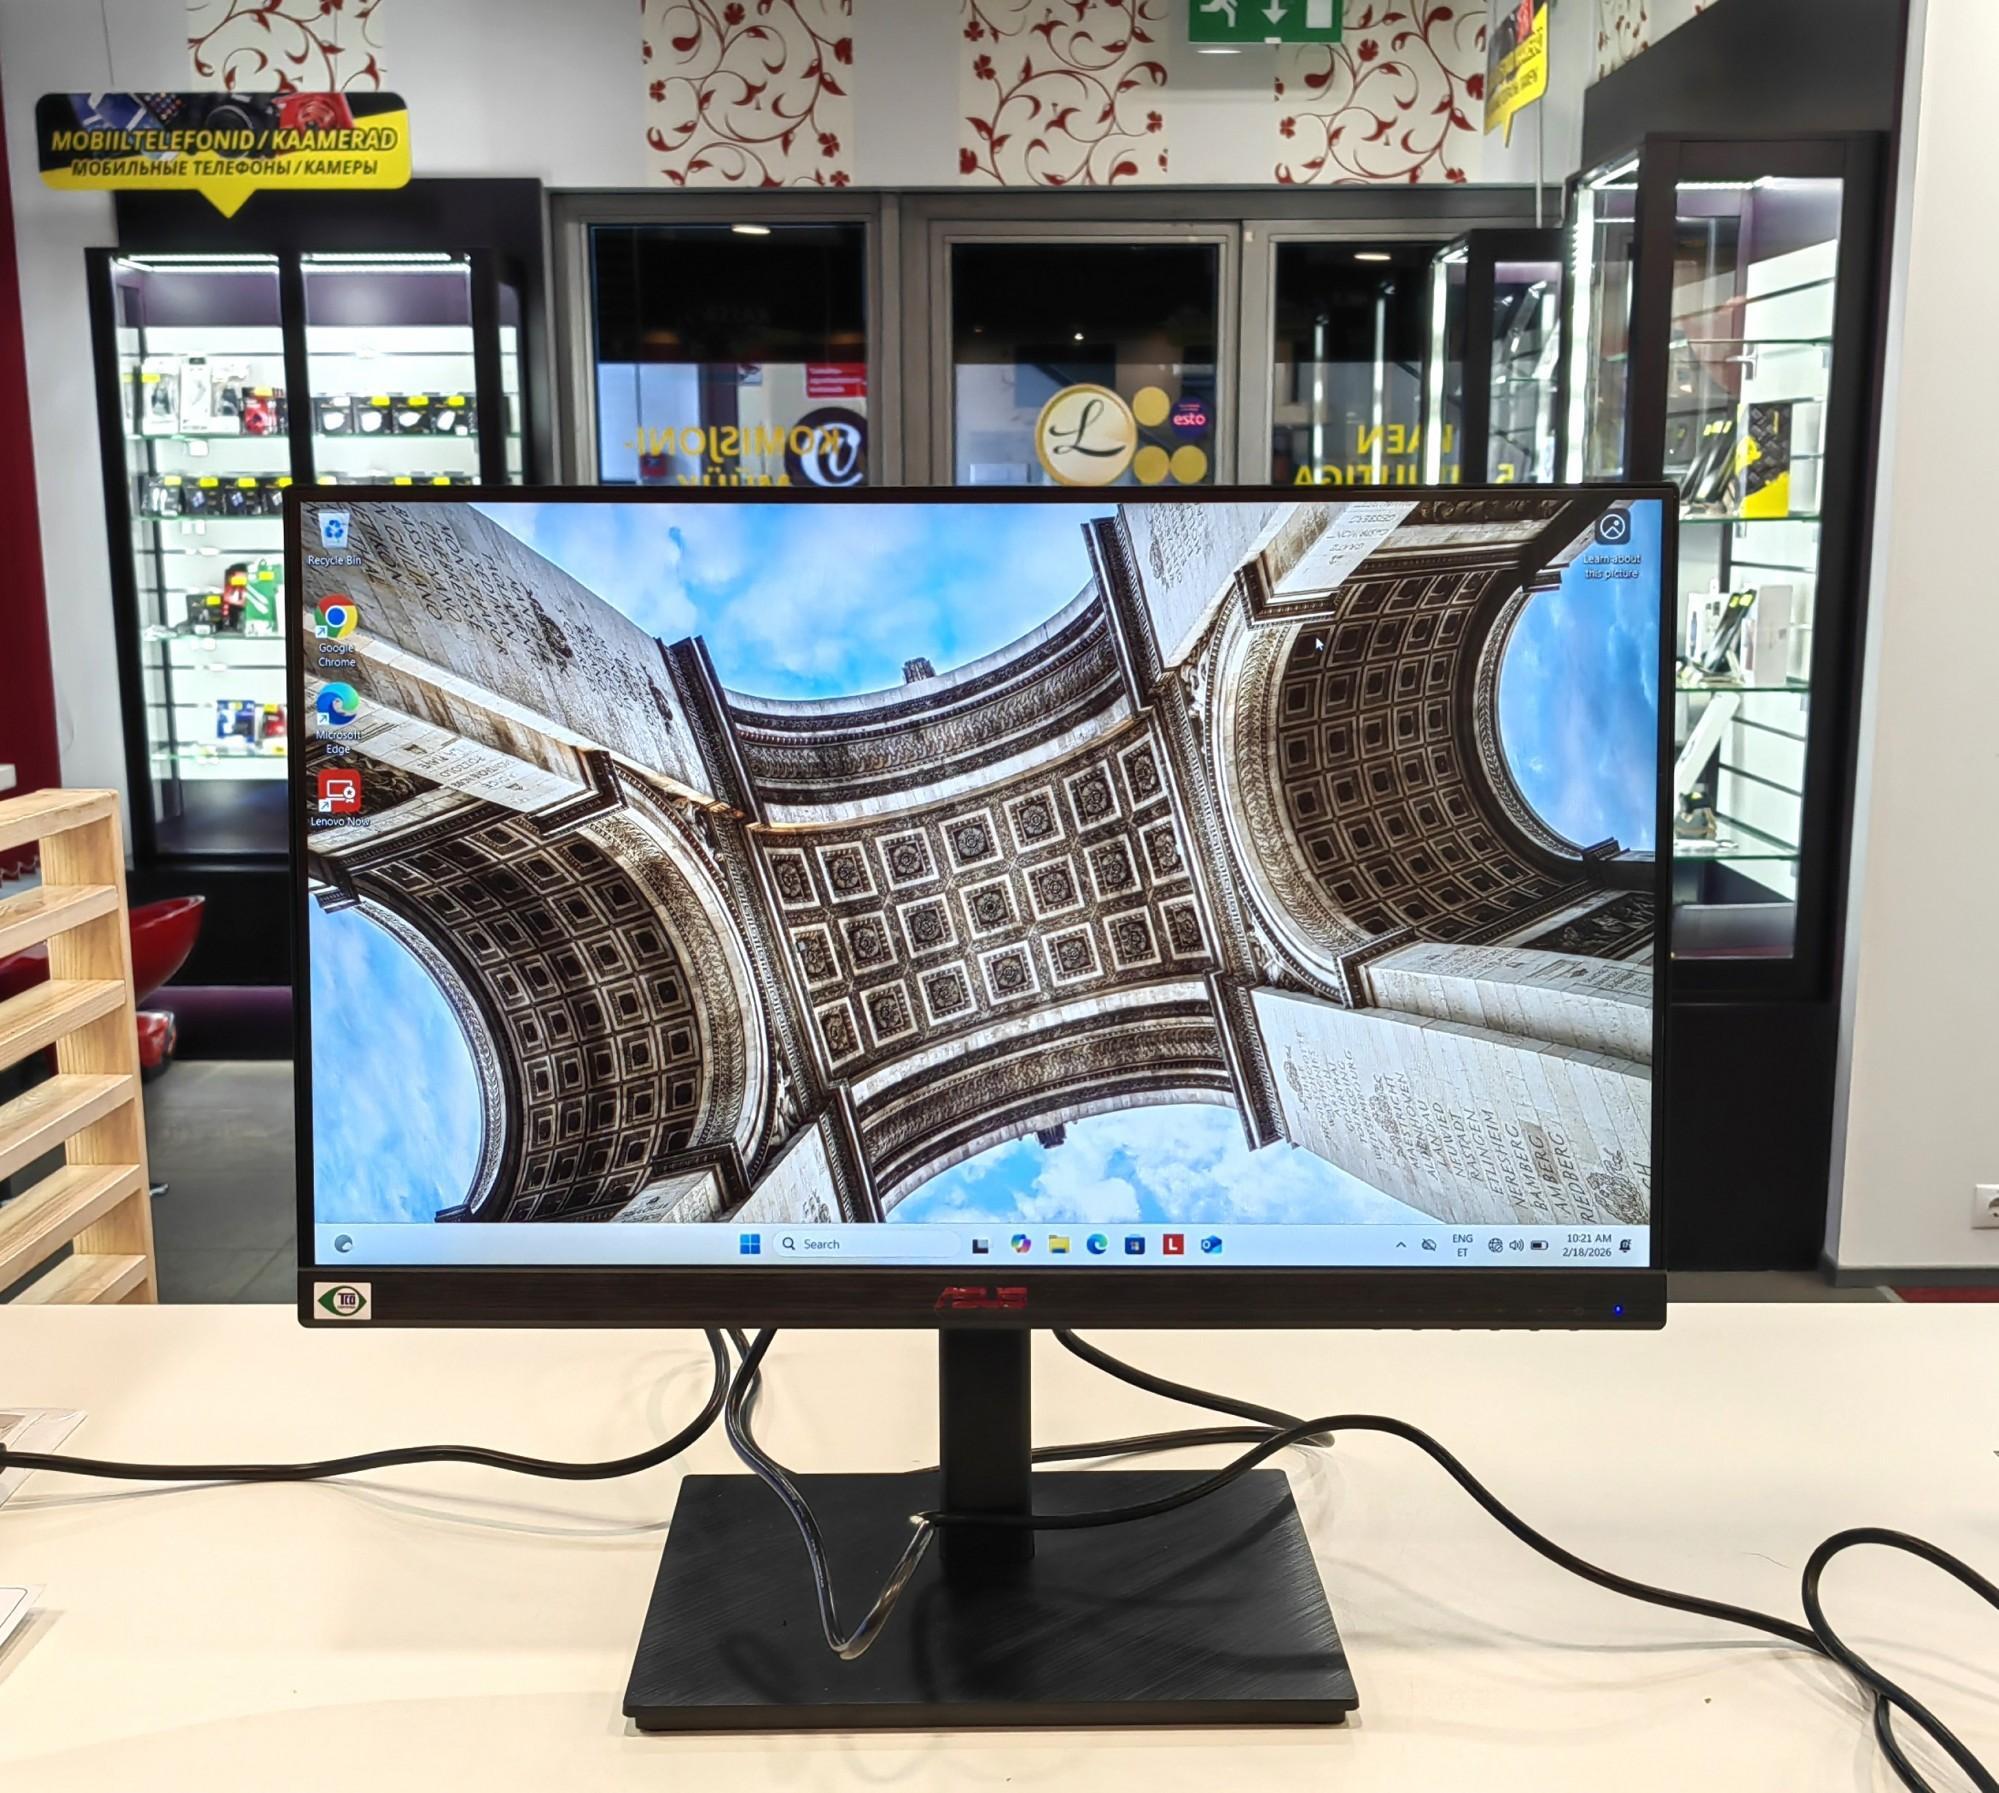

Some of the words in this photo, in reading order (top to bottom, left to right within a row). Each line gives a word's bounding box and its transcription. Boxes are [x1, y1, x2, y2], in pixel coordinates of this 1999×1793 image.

[51, 129, 252, 151] MOBIILTELEFONID
[271, 127, 398, 151] KAAMERAD
[72, 160, 188, 177] МОБИЛЬНЫЕ
[193, 160, 290, 177] ТЕЛЕФОНЫ
[304, 160, 378, 176] КАМЕРЫ
[1172, 412, 1206, 426] esto
[308, 555, 344, 567] Recycle
[346, 555, 362, 566] Bin
[1583, 554, 1610, 565] Learn
[1611, 553, 1642, 565] about
[1585, 568, 1602, 579] this
[1604, 568, 1640, 580] picture
[319, 644, 354, 656] Google
[318, 656, 356, 667] Chrome
[316, 730, 362, 740] Microsoft
[326, 744, 351, 755] Edge
[311, 817, 345, 827] Lenovo
[348, 817, 371, 827] Now
[1503, 1123, 1548, 1209] BAMBERG
[1528, 1134, 1570, 1214] AMBERG
[1547, 1131, 1596, 1223] RIEDBERG
[803, 1236, 841, 1251] Search
[1452, 1233, 1474, 1243] ENG
[1567, 1233, 1593, 1243] 10:21
[1595, 1233, 1612, 1243] AM
[1456, 1248, 1469, 1257] ET
[1562, 1247, 1612, 1257] 2/18/2026
